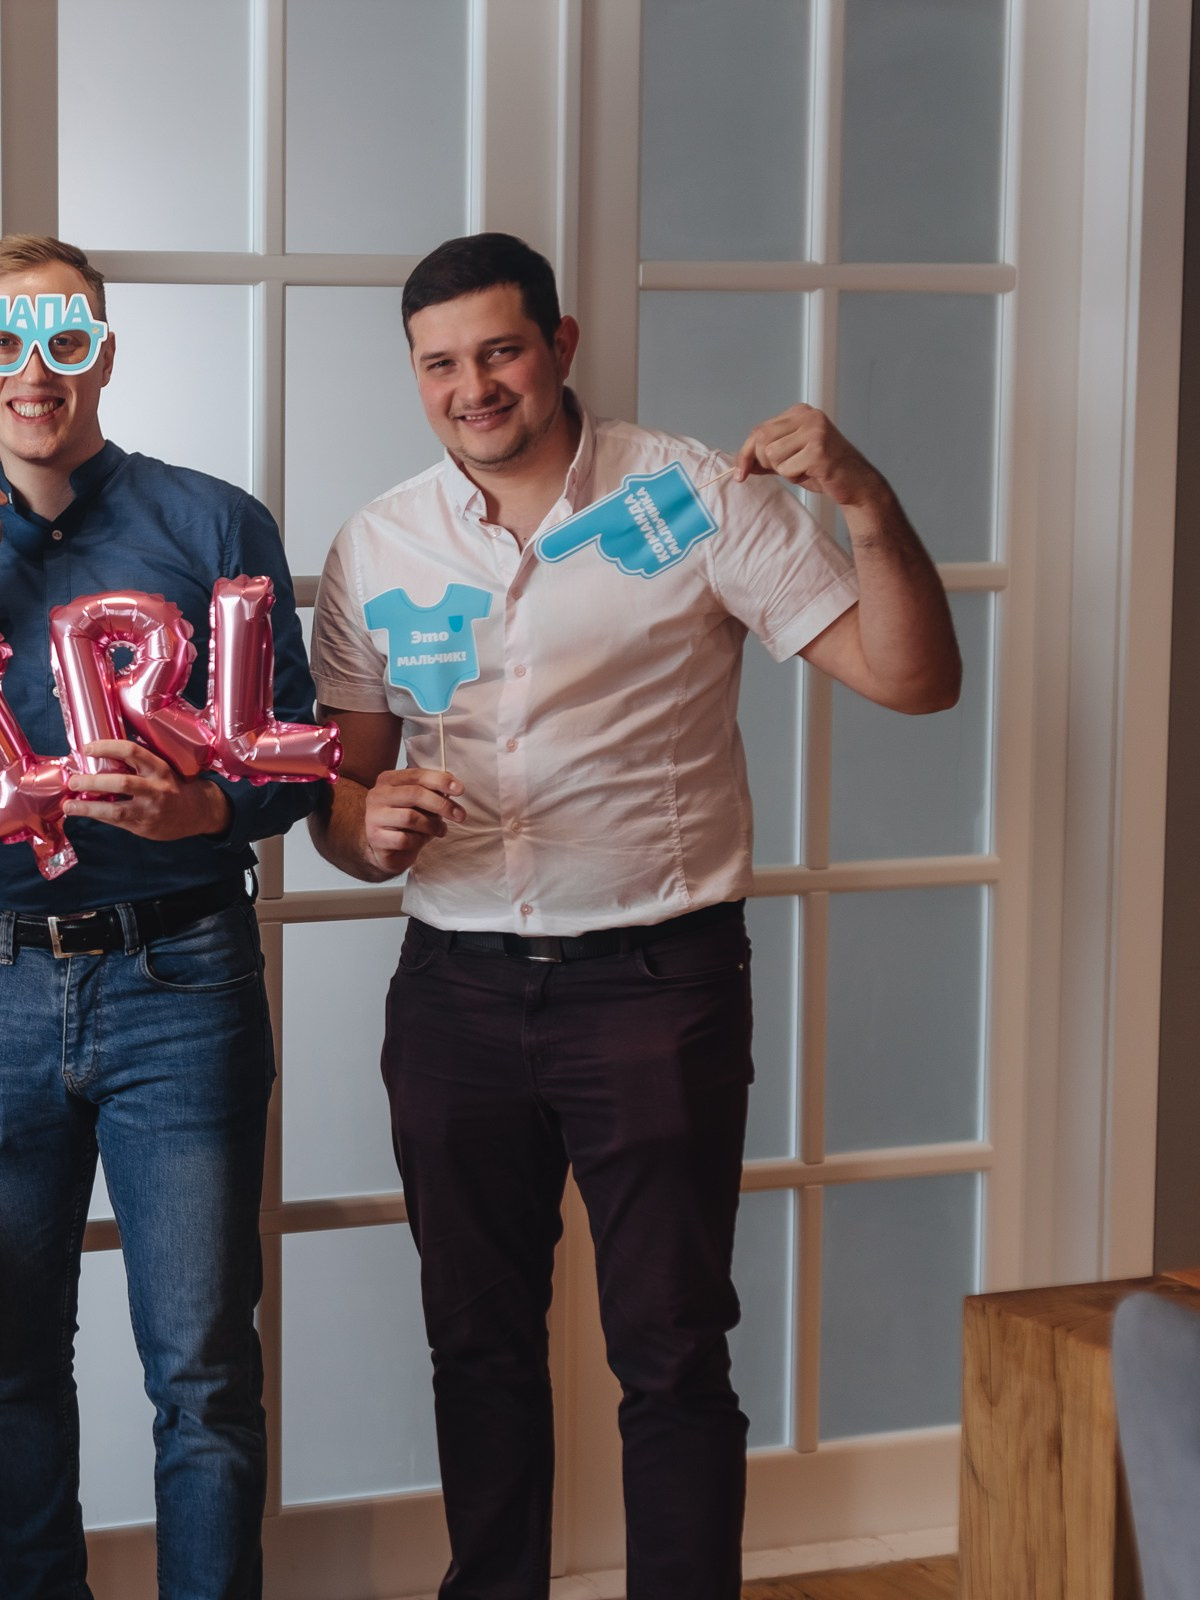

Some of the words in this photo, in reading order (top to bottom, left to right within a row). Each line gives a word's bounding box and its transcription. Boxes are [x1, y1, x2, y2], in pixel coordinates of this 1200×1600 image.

[624, 493, 670, 563] КОМАНДА
[636, 486, 682, 555] МАЛЬЧИКА
[410, 630, 449, 644] Это
[397, 651, 467, 667] МАЛЬЧИК!
